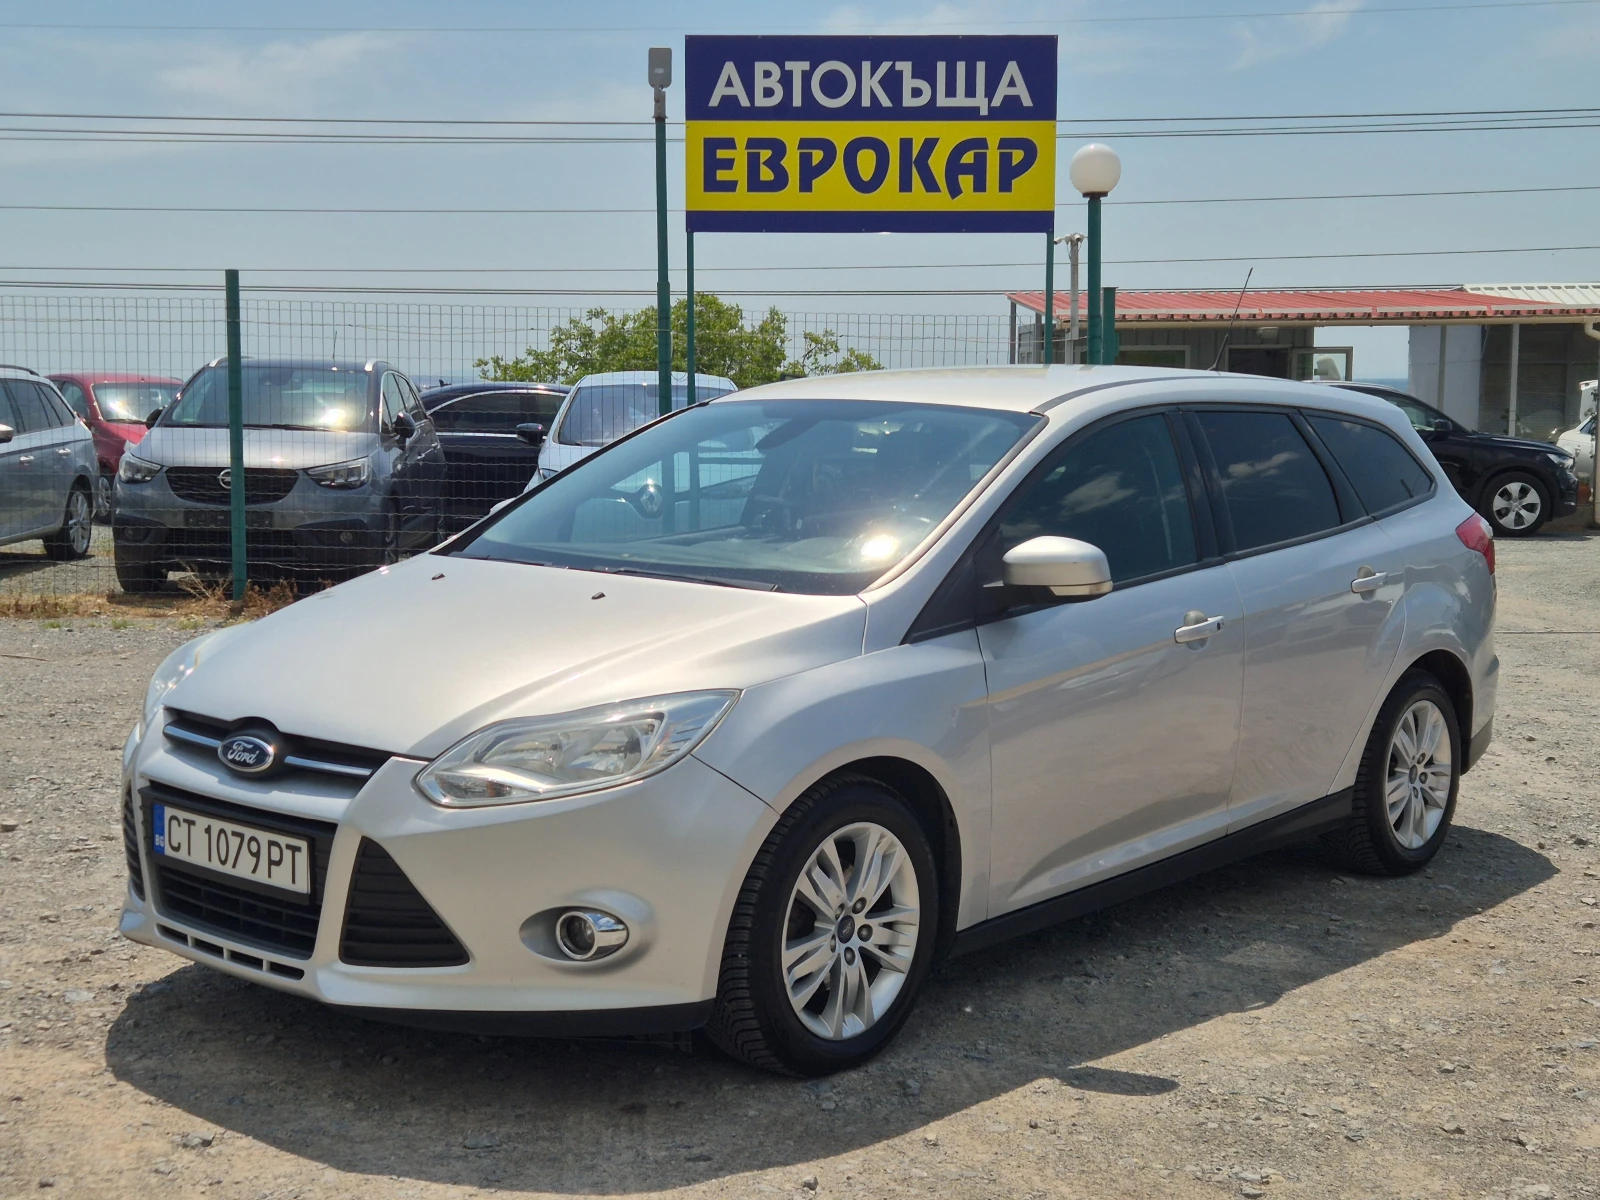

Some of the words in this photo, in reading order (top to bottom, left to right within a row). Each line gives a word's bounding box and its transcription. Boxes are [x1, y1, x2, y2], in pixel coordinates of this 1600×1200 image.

[708, 60, 1033, 115] АВТОКЪЩА
[703, 136, 1038, 200] ЕВРОКАР
[227, 740, 259, 764] Ford
[167, 815, 196, 856] CT
[204, 824, 260, 874] 1079
[267, 840, 302, 885] PT
